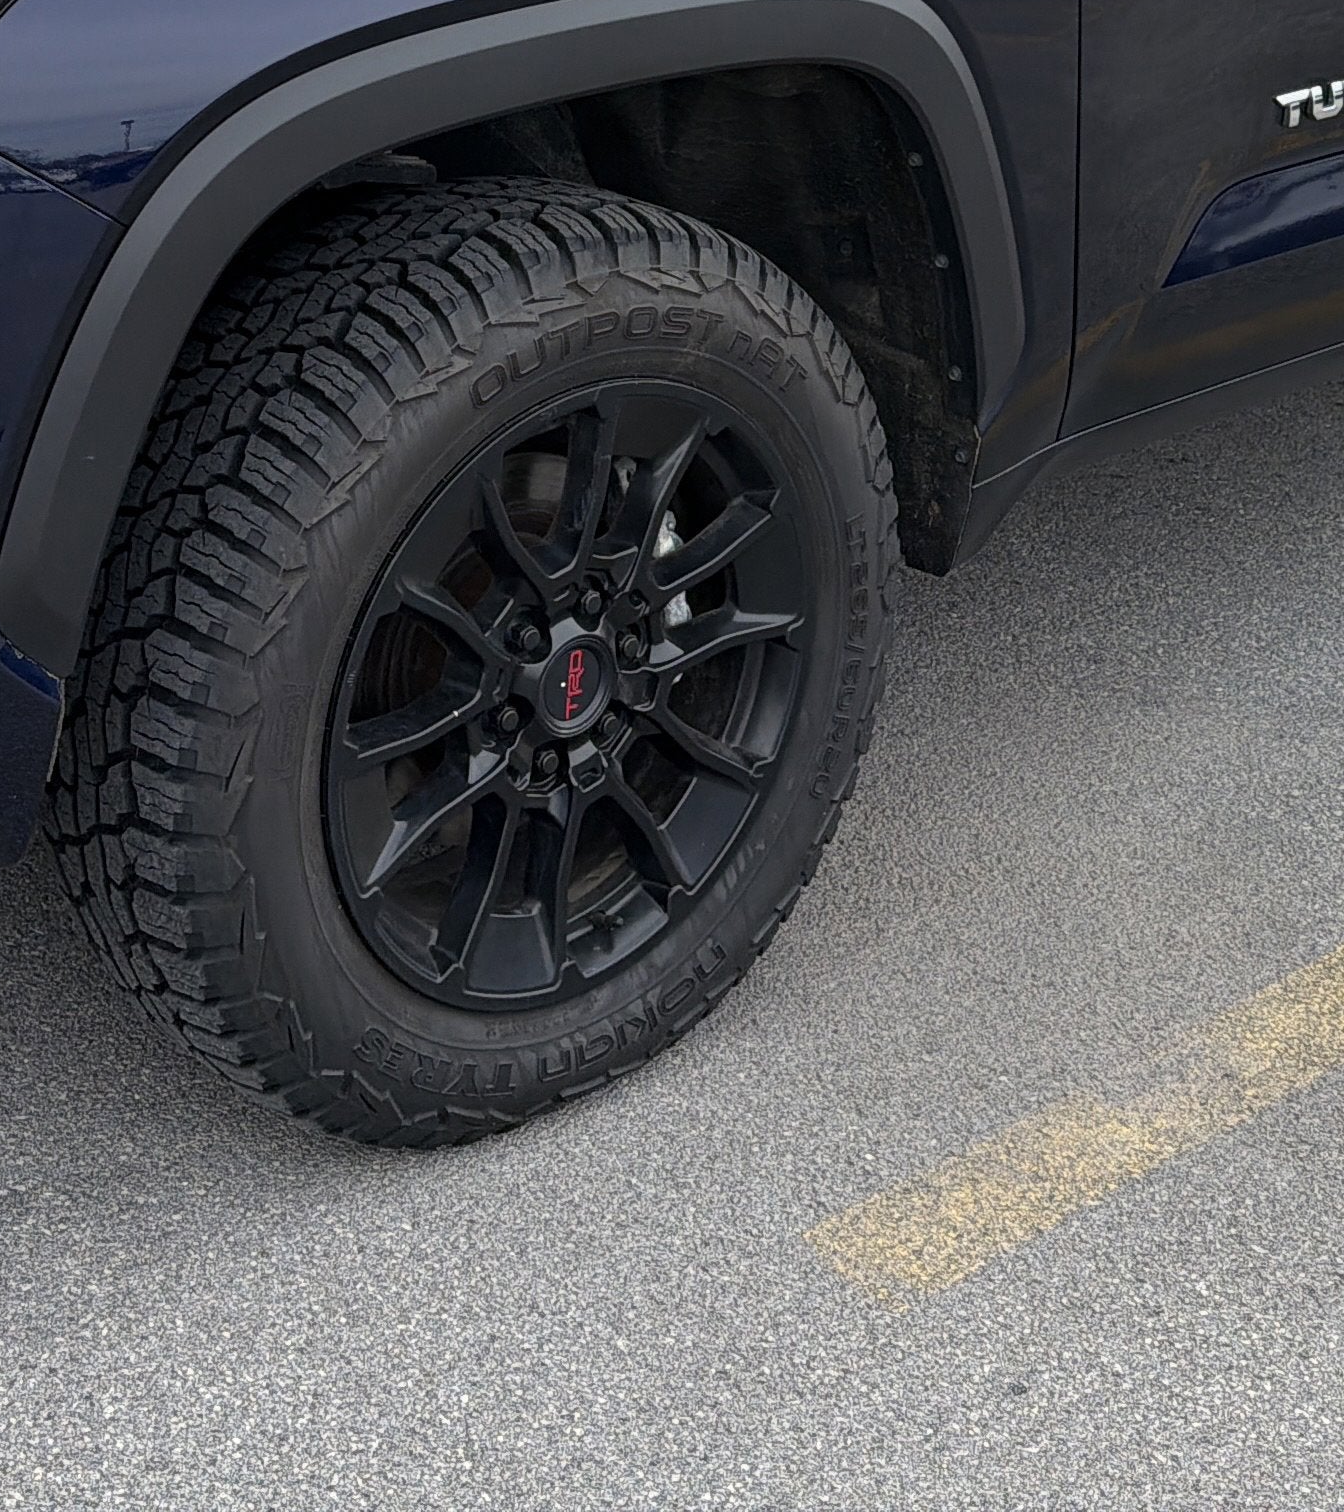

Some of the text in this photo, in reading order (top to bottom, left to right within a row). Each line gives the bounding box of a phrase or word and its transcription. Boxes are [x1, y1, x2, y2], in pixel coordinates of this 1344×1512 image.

[469, 304, 724, 409] OUTPOST
[565, 649, 585, 720] TRD
[353, 1025, 517, 1098] TYRES
